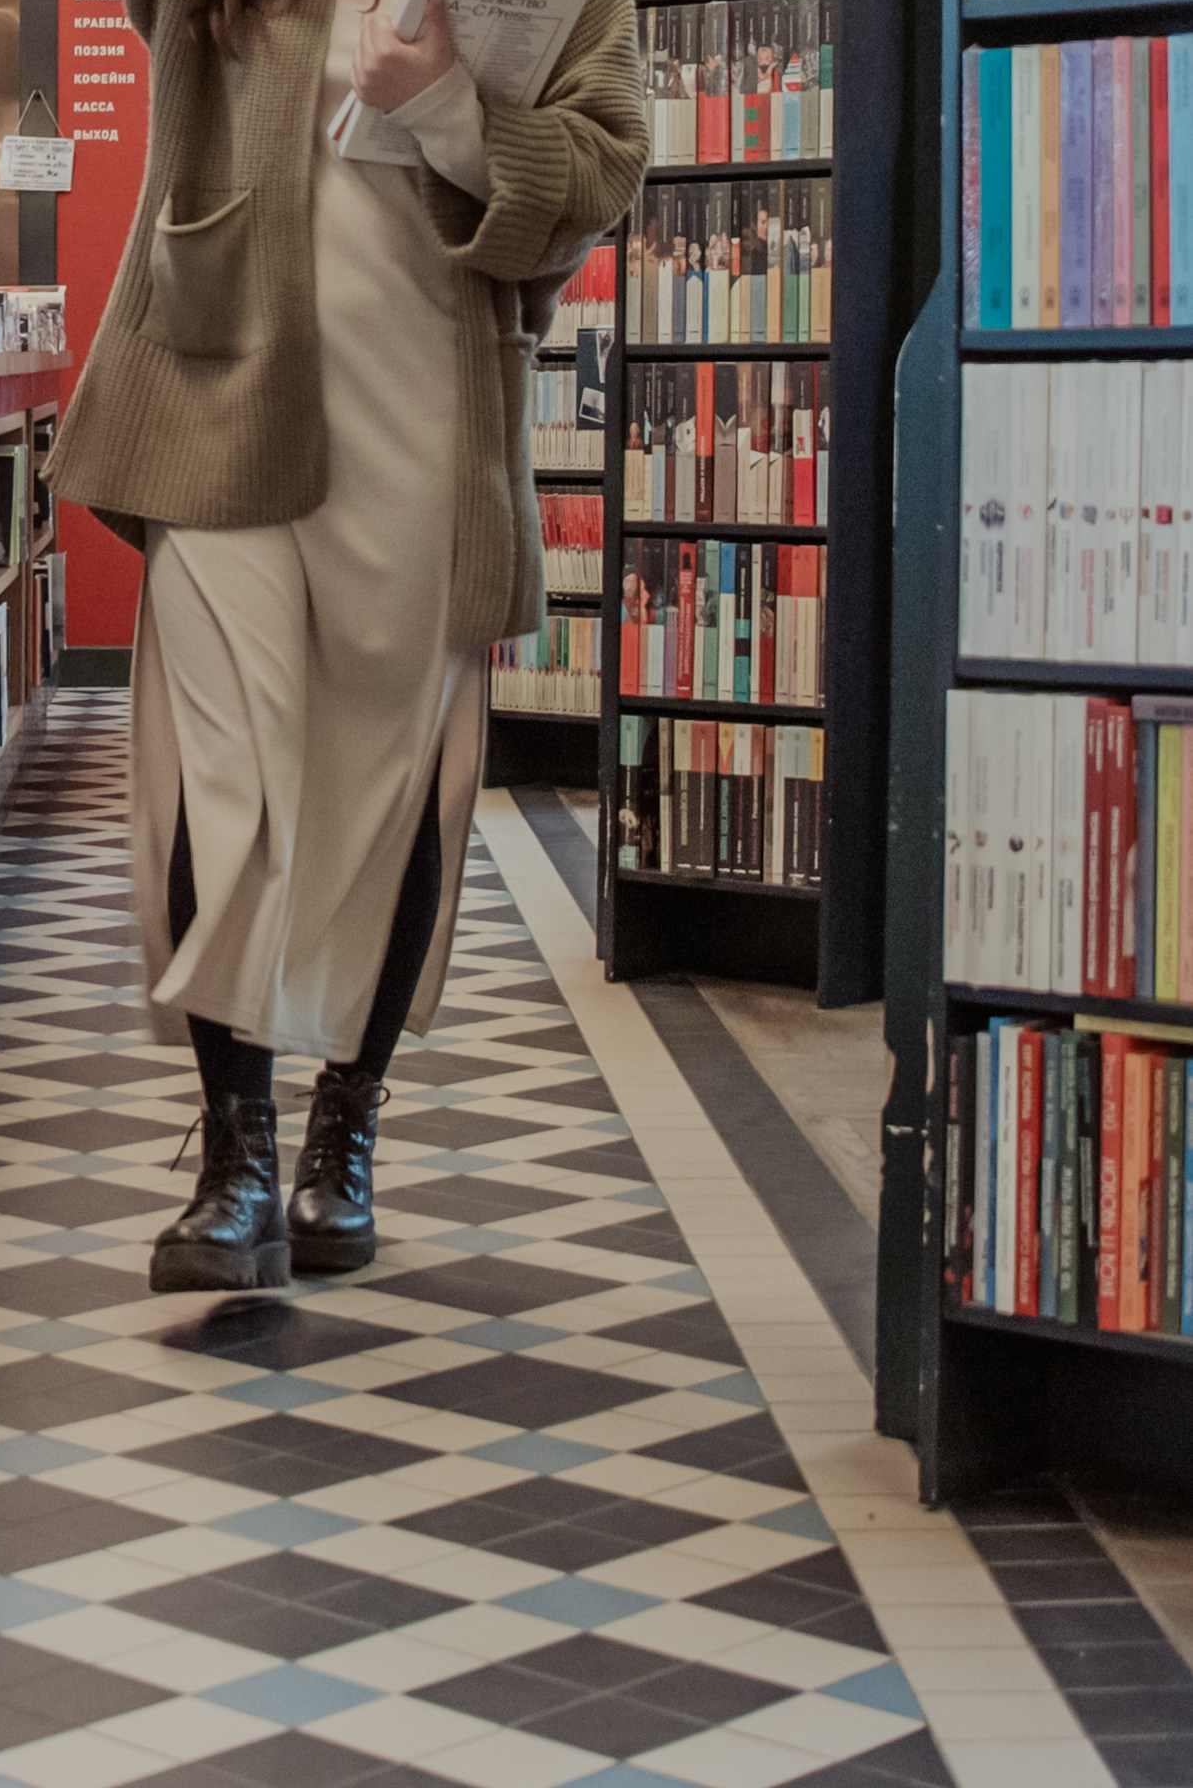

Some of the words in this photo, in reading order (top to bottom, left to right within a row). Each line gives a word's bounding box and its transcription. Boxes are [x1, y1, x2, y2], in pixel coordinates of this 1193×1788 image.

[488, 5, 533, 23] Press
[74, 45, 125, 56] ПОЭЗИЯ
[74, 71, 136, 84] КОФЕЙНЯ
[74, 102, 115, 112] КАССА
[74, 129, 119, 141] ВЫХОД
[1101, 1156, 1116, 1229] ЛЮБОВЬ
[1100, 1253, 1116, 1299] ВОЛЯ
